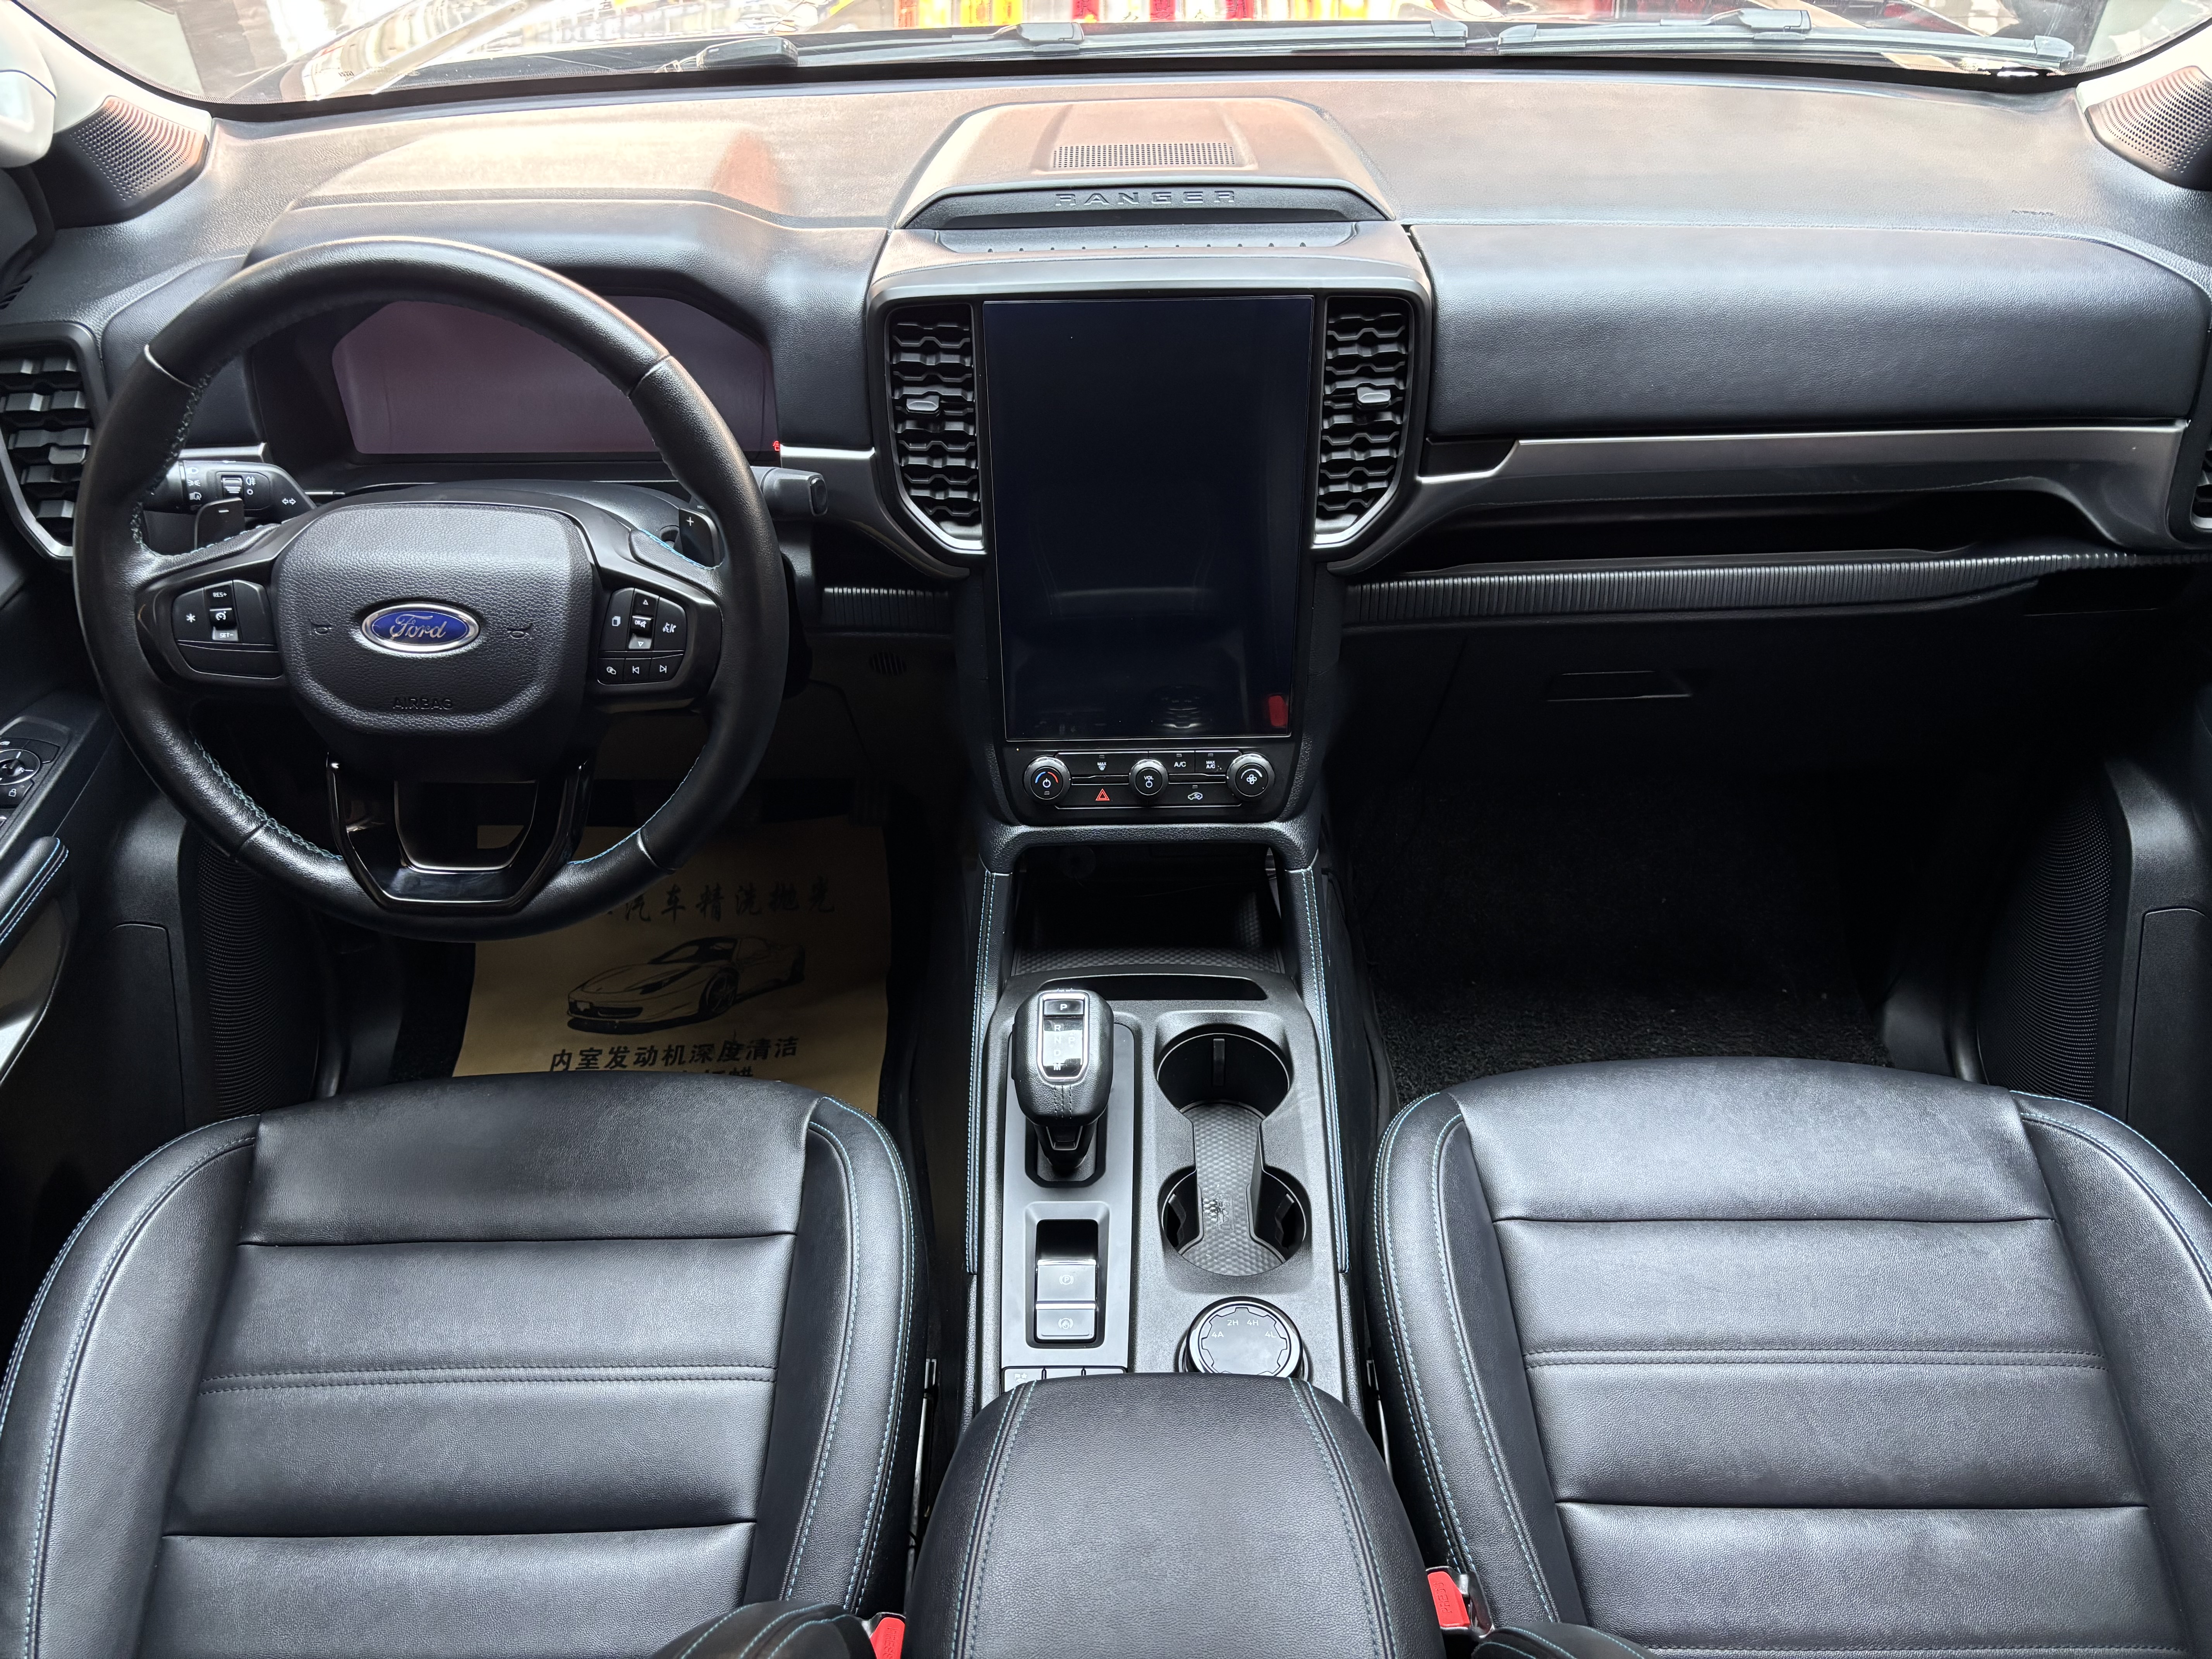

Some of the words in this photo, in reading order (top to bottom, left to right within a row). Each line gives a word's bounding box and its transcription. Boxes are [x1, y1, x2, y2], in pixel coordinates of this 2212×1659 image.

[1055, 191, 1235, 206] RANGER
[390, 614, 447, 638] Ford
[393, 697, 453, 710] AIRBAG
[606, 874, 835, 922] 汽车精洗抛光
[550, 1035, 799, 1072] 内室发动机深度清洁
[1433, 1582, 1452, 1613] PRESS
